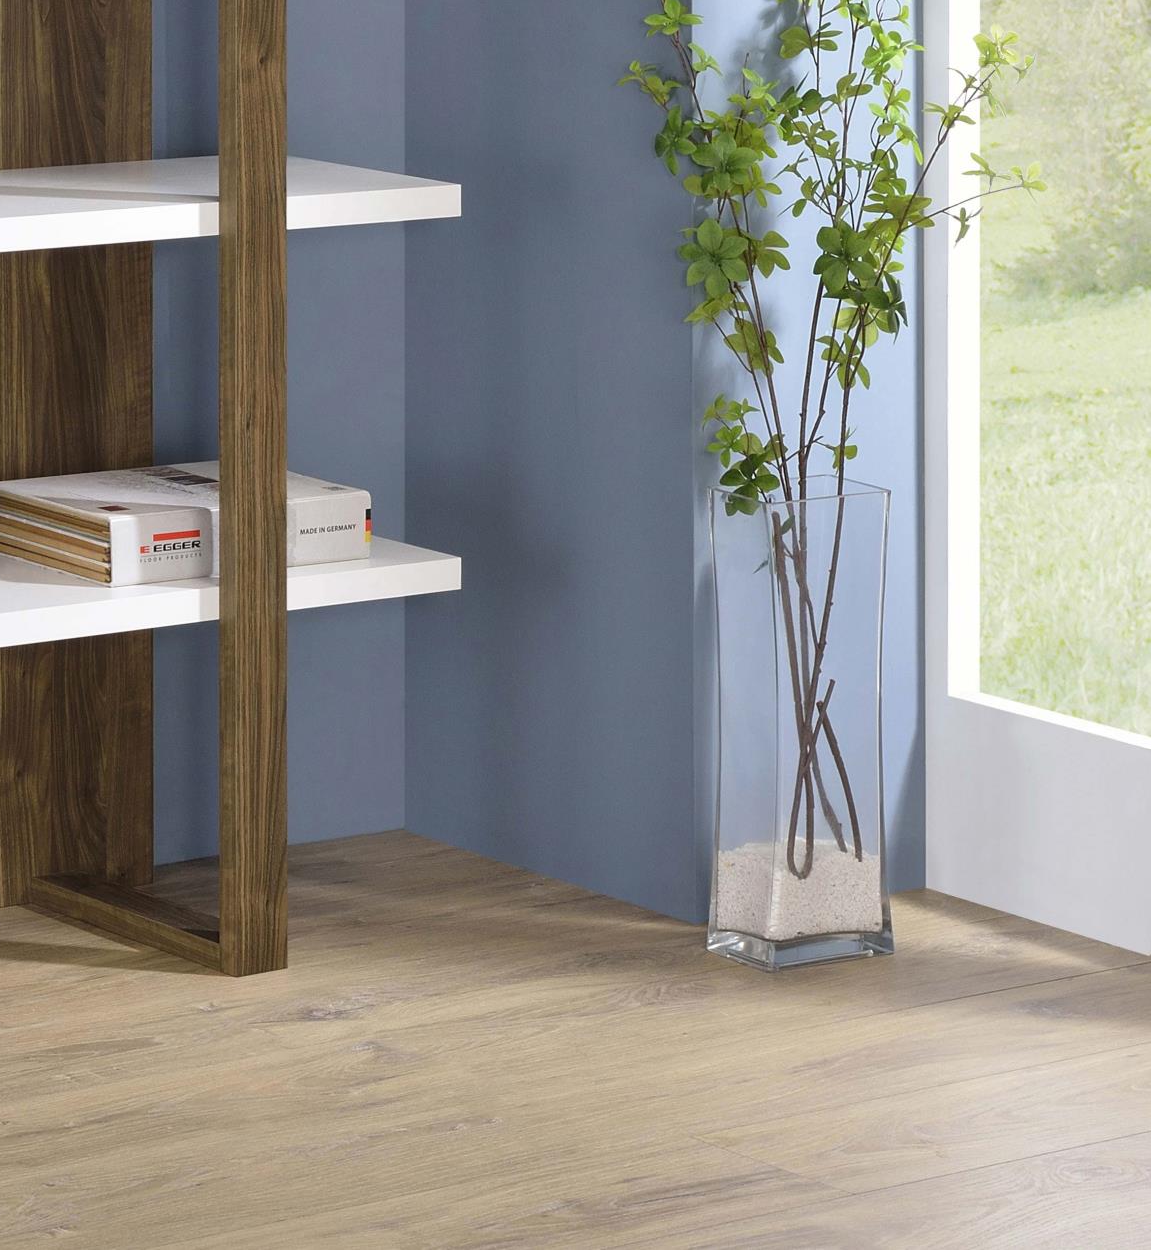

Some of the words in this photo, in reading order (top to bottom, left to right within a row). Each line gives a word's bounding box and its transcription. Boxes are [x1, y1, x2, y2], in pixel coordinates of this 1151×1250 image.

[300, 527, 317, 535] MADE
[326, 524, 356, 532] GERMANY
[153, 540, 201, 552] EGGER
